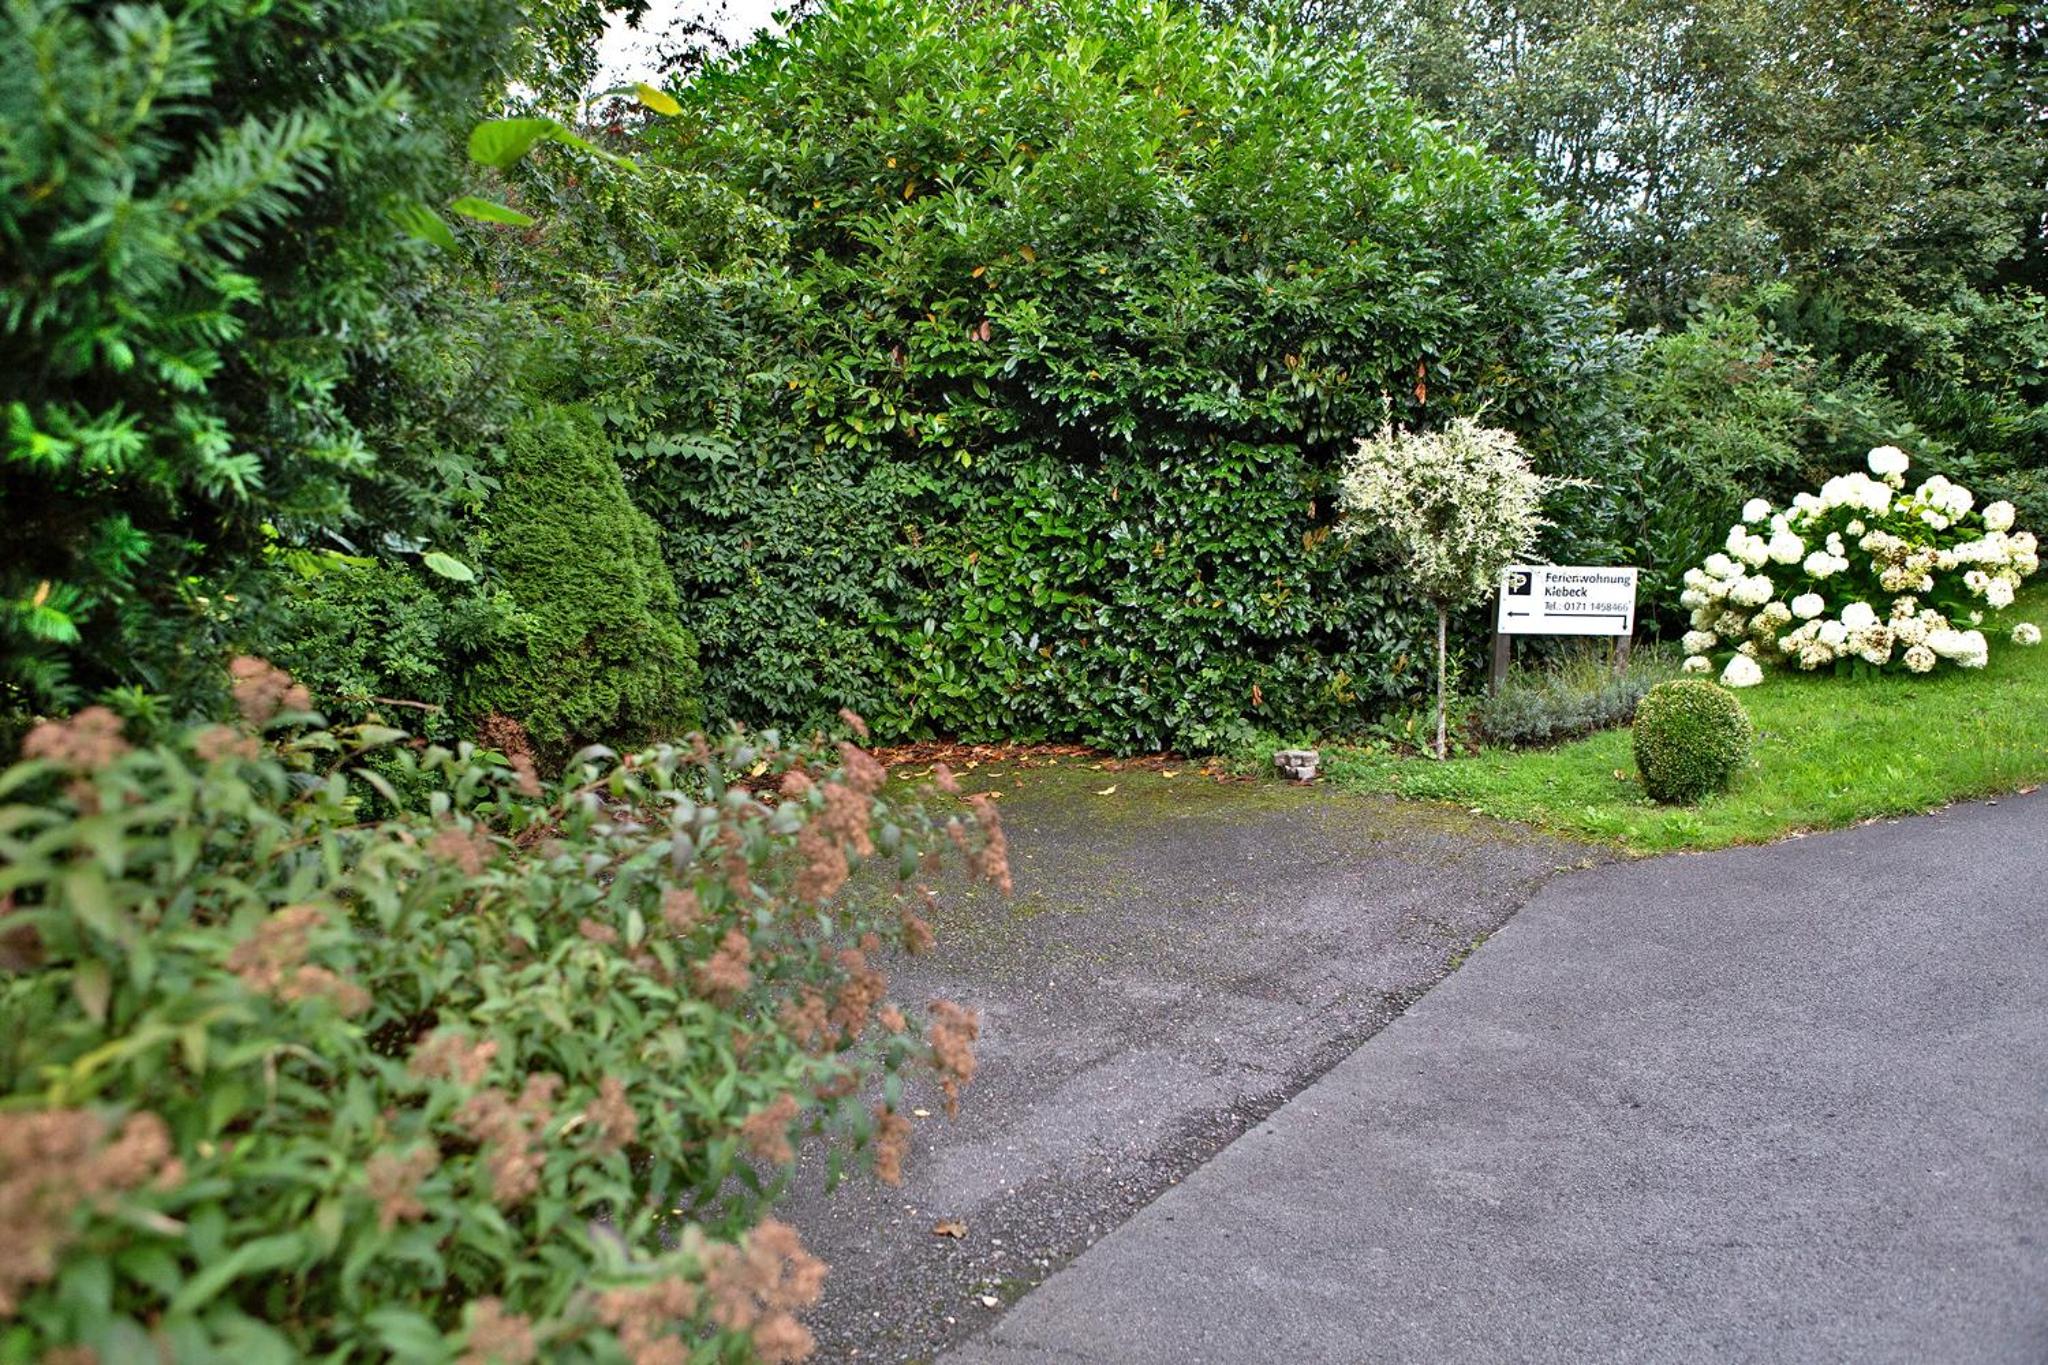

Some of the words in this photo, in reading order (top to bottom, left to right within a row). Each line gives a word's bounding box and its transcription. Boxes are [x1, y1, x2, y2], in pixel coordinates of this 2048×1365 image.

[1513, 574, 1527, 593] P
[1546, 572, 1631, 587] Ferienwohnung
[1545, 586, 1588, 597] Kiebeck
[1564, 601, 1586, 611] 0171
